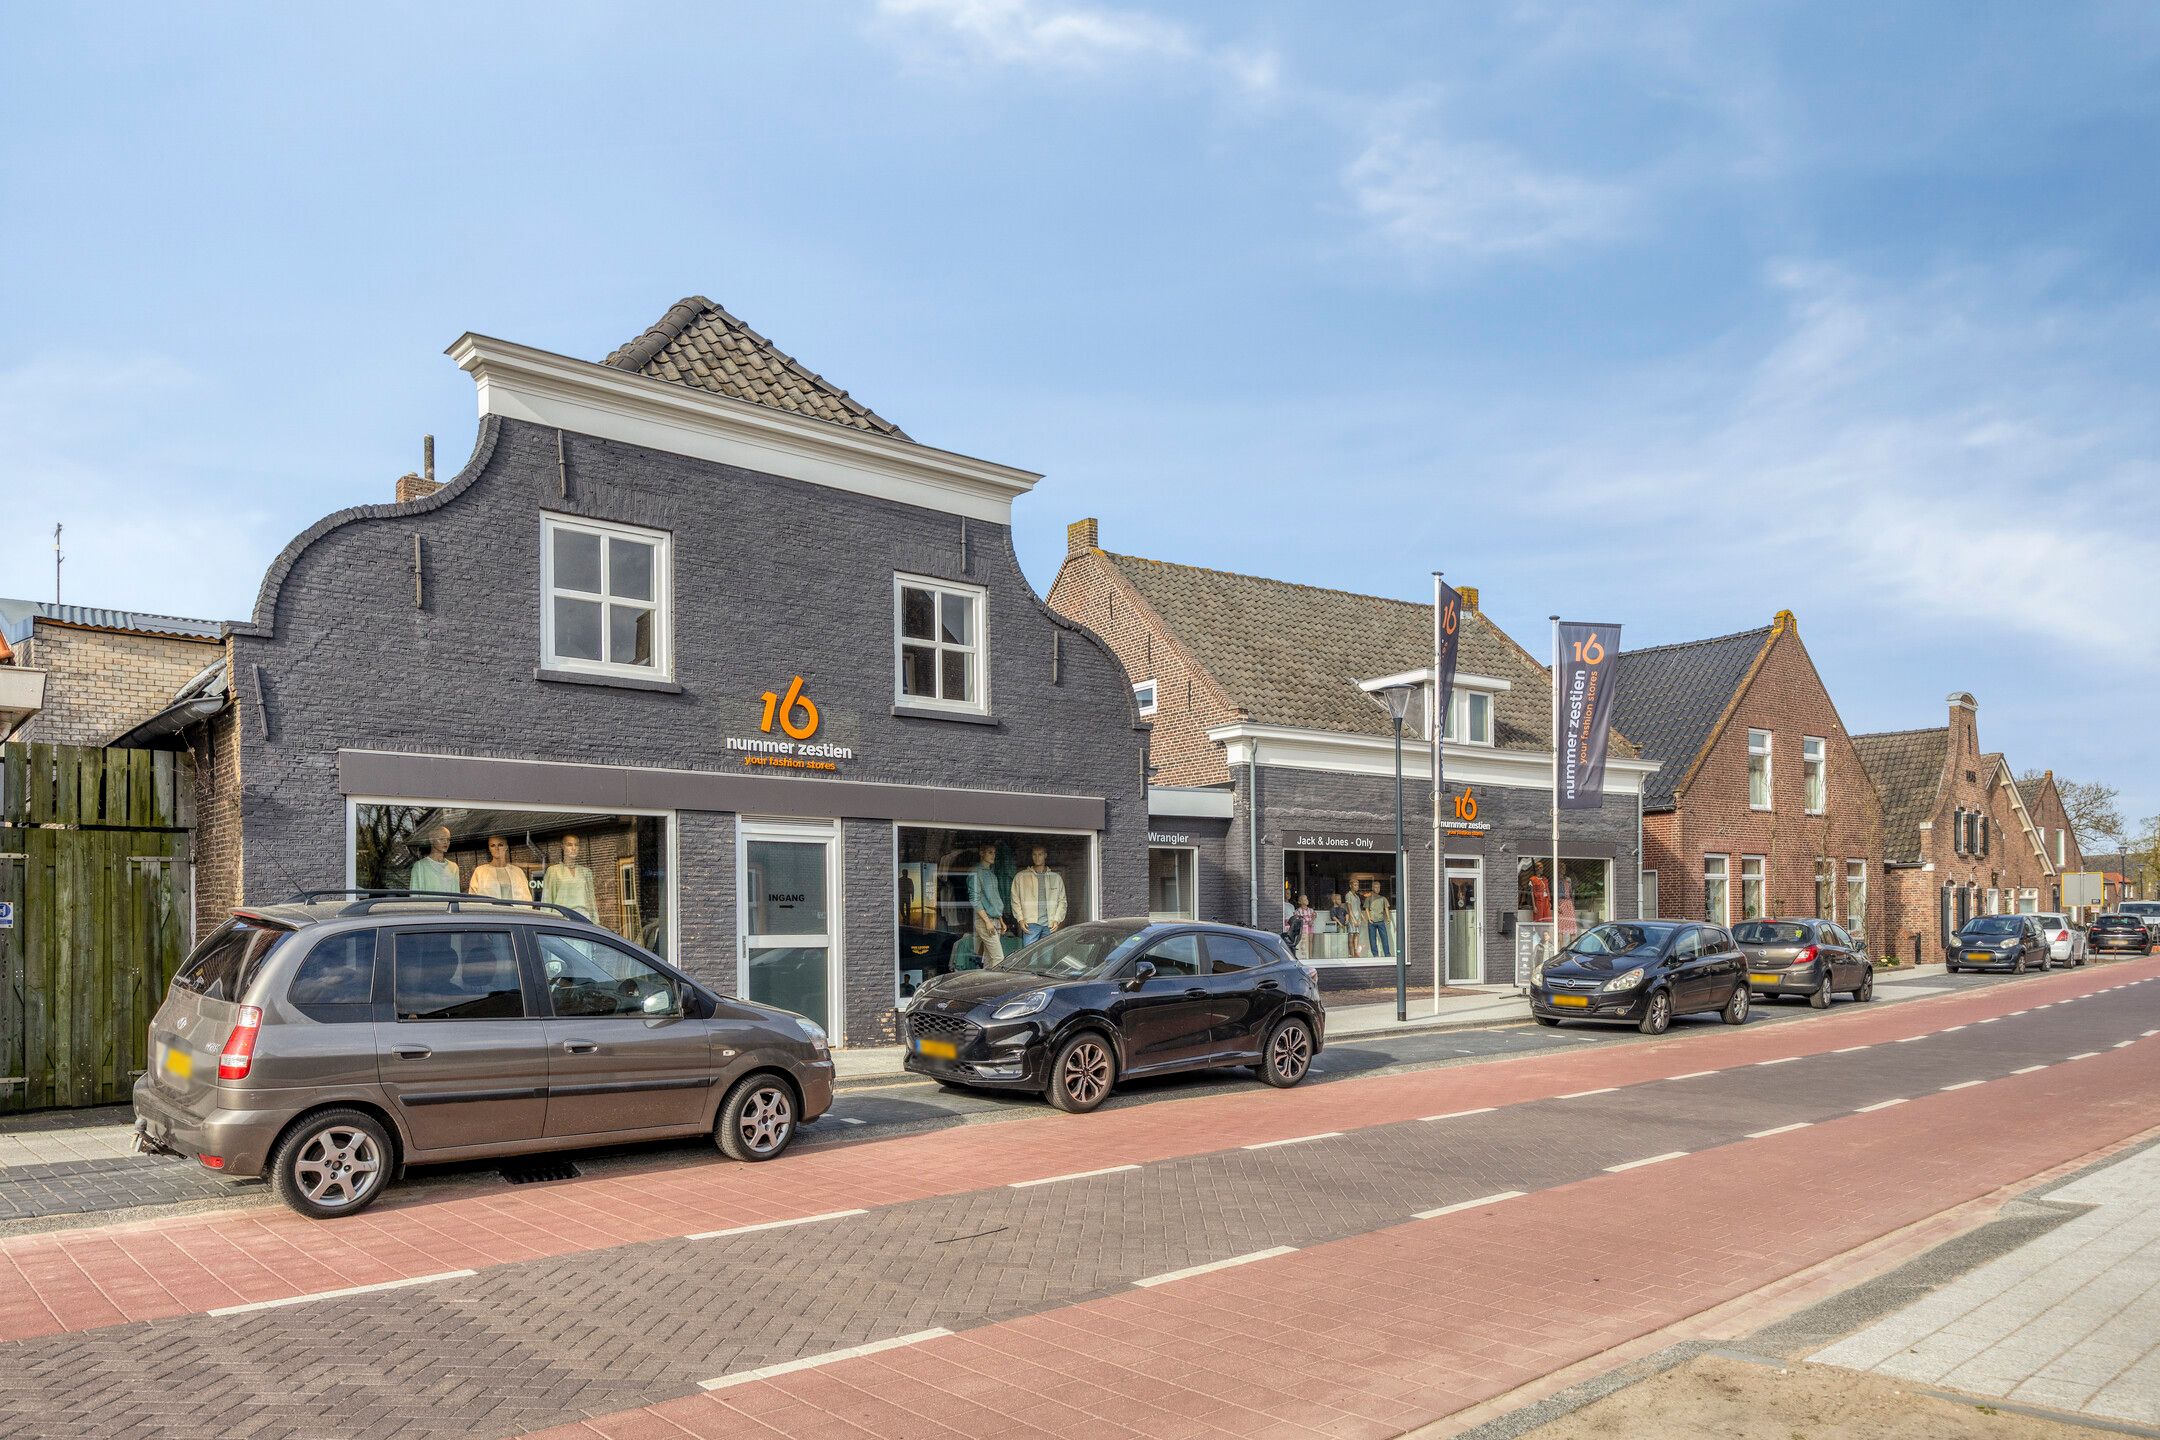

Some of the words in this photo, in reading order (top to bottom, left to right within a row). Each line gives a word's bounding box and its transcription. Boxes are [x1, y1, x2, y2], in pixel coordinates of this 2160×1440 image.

[1442, 599, 1457, 635] 16
[1573, 632, 1605, 665] 16
[1569, 670, 1586, 729] zestien
[1588, 671, 1598, 701] stores
[760, 675, 819, 740] 16
[1581, 703, 1594, 739] fashion
[726, 737, 795, 754] nummer
[797, 743, 852, 759] zestien
[744, 756, 767, 766] your
[769, 757, 805, 768] fashion
[806, 760, 836, 770] stores
[1580, 741, 1588, 764] your
[1566, 732, 1578, 800] nummer
[1454, 786, 1478, 820] 16
[1147, 831, 1190, 845] Wrangler
[1440, 821, 1467, 829] nummer
[1468, 821, 1491, 830] zestien
[1296, 836, 1316, 845] Jack
[1317, 836, 1324, 846] &
[1325, 837, 1349, 847] Jones
[1355, 837, 1374, 849] Only
[768, 894, 805, 902] INGANG
